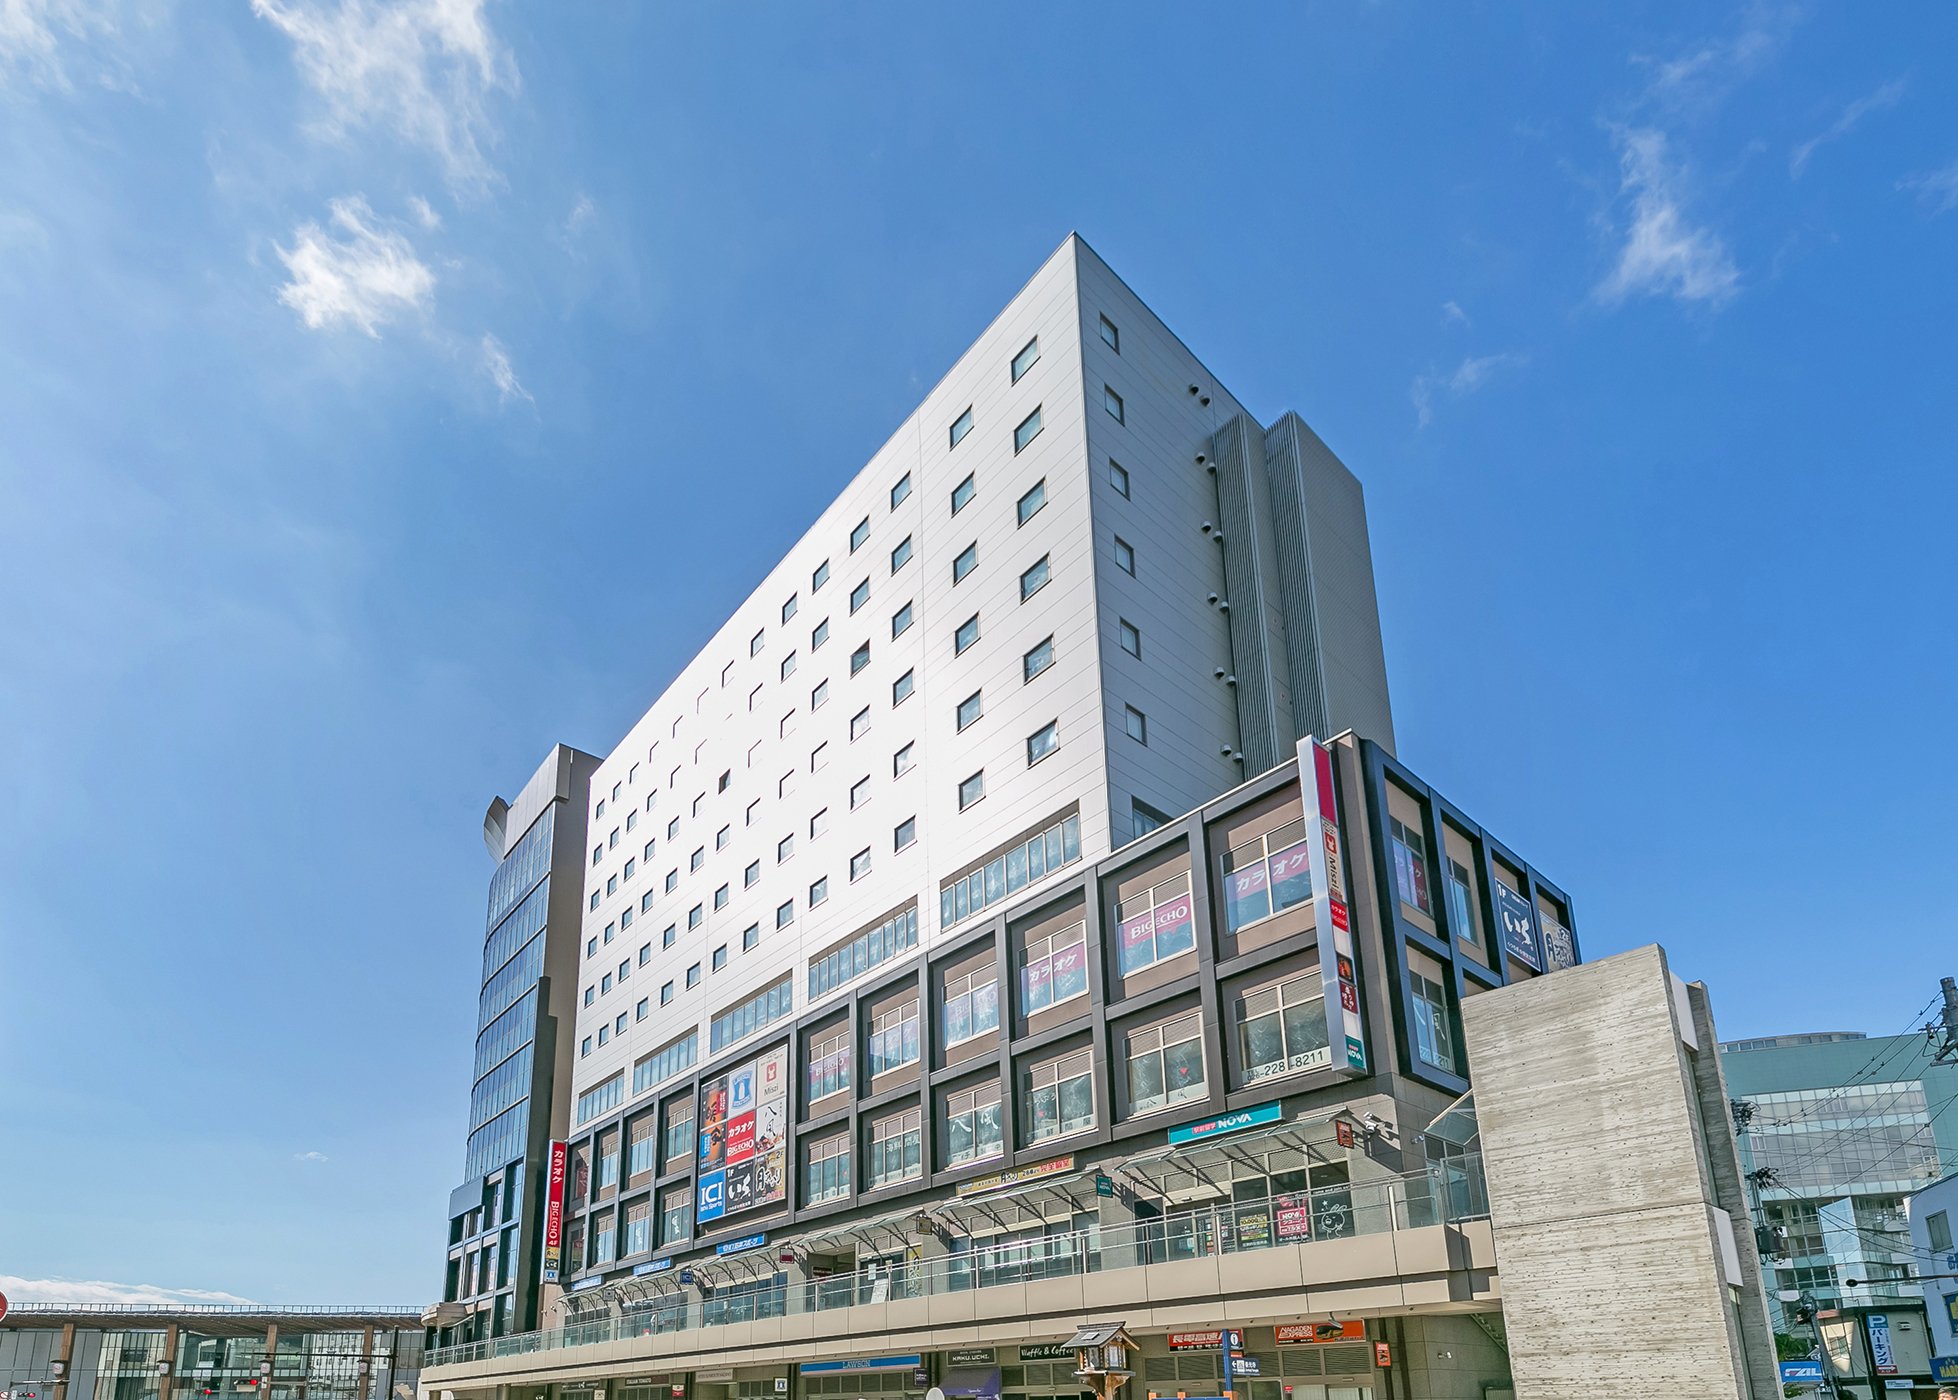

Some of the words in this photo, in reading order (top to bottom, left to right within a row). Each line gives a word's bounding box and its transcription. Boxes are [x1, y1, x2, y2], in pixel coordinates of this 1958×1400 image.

[1236, 852, 1306, 893] カラオケ
[1030, 953, 1077, 982] カラオケ
[728, 1120, 755, 1138] カラオケ
[1218, 1113, 1252, 1129] NOVA
[552, 1150, 564, 1184] カラオケ
[701, 1182, 723, 1205] ICI
[1868, 1315, 1886, 1328] P
[1043, 1346, 1050, 1355] &
[1872, 1329, 1888, 1365] パーキング
[842, 1359, 871, 1369] LAWSON
